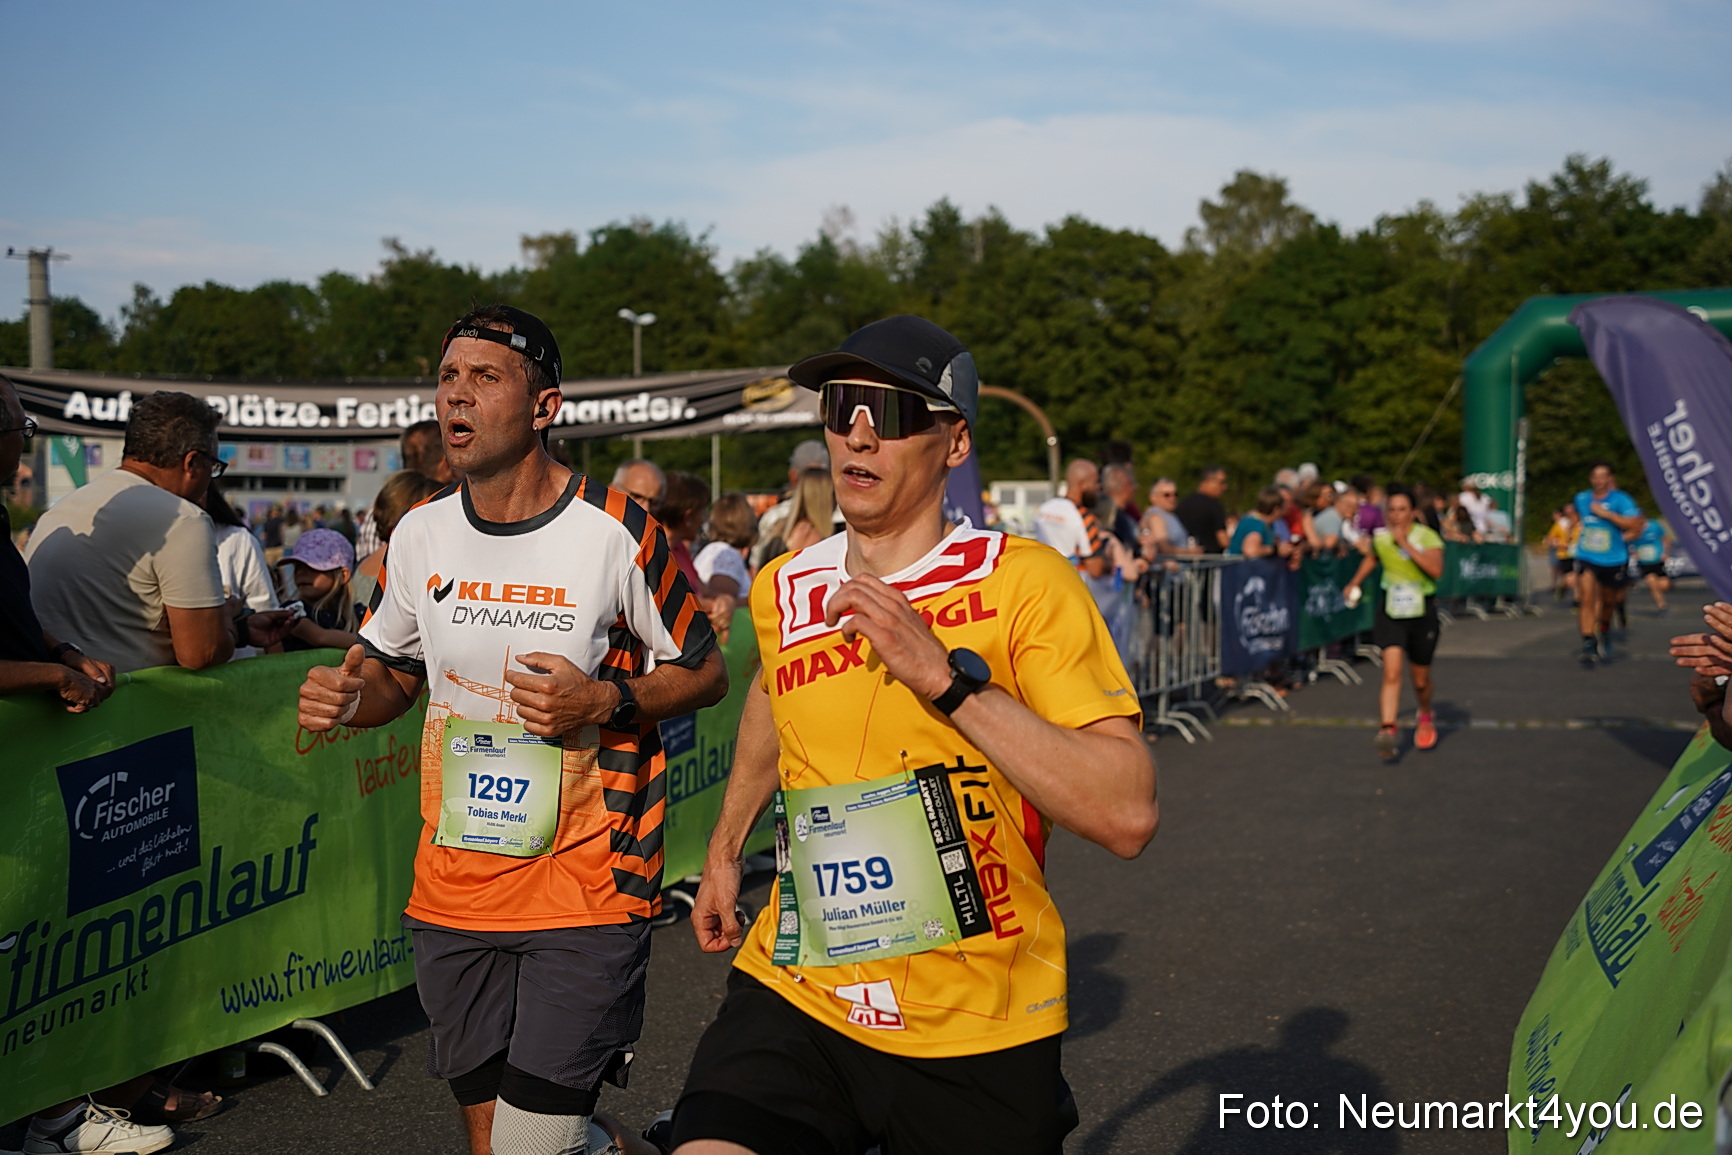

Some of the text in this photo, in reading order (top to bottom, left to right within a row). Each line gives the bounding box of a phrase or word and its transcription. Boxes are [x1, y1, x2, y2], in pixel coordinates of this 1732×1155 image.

[64, 391, 133, 421] Auf
[550, 392, 698, 426] nander.
[458, 581, 577, 608] KLEBL
[451, 606, 576, 632] DYNAMICS
[776, 637, 866, 697] MAX
[93, 782, 176, 830] Fischer
[468, 773, 531, 804] 1297
[918, 778, 937, 820] RABATT
[928, 777, 942, 808] OUTLET
[101, 807, 169, 842] AUTOMOBILE
[467, 806, 528, 823] Tobias Merkl
[937, 808, 952, 842] FACTORY
[932, 828, 944, 845] 20
[812, 856, 894, 897] 1759
[4, 813, 319, 1020] firmenlauf
[822, 900, 906, 922] Julian Müller
[953, 874, 976, 926] HILTL
[3, 965, 149, 1057] neumarkt
